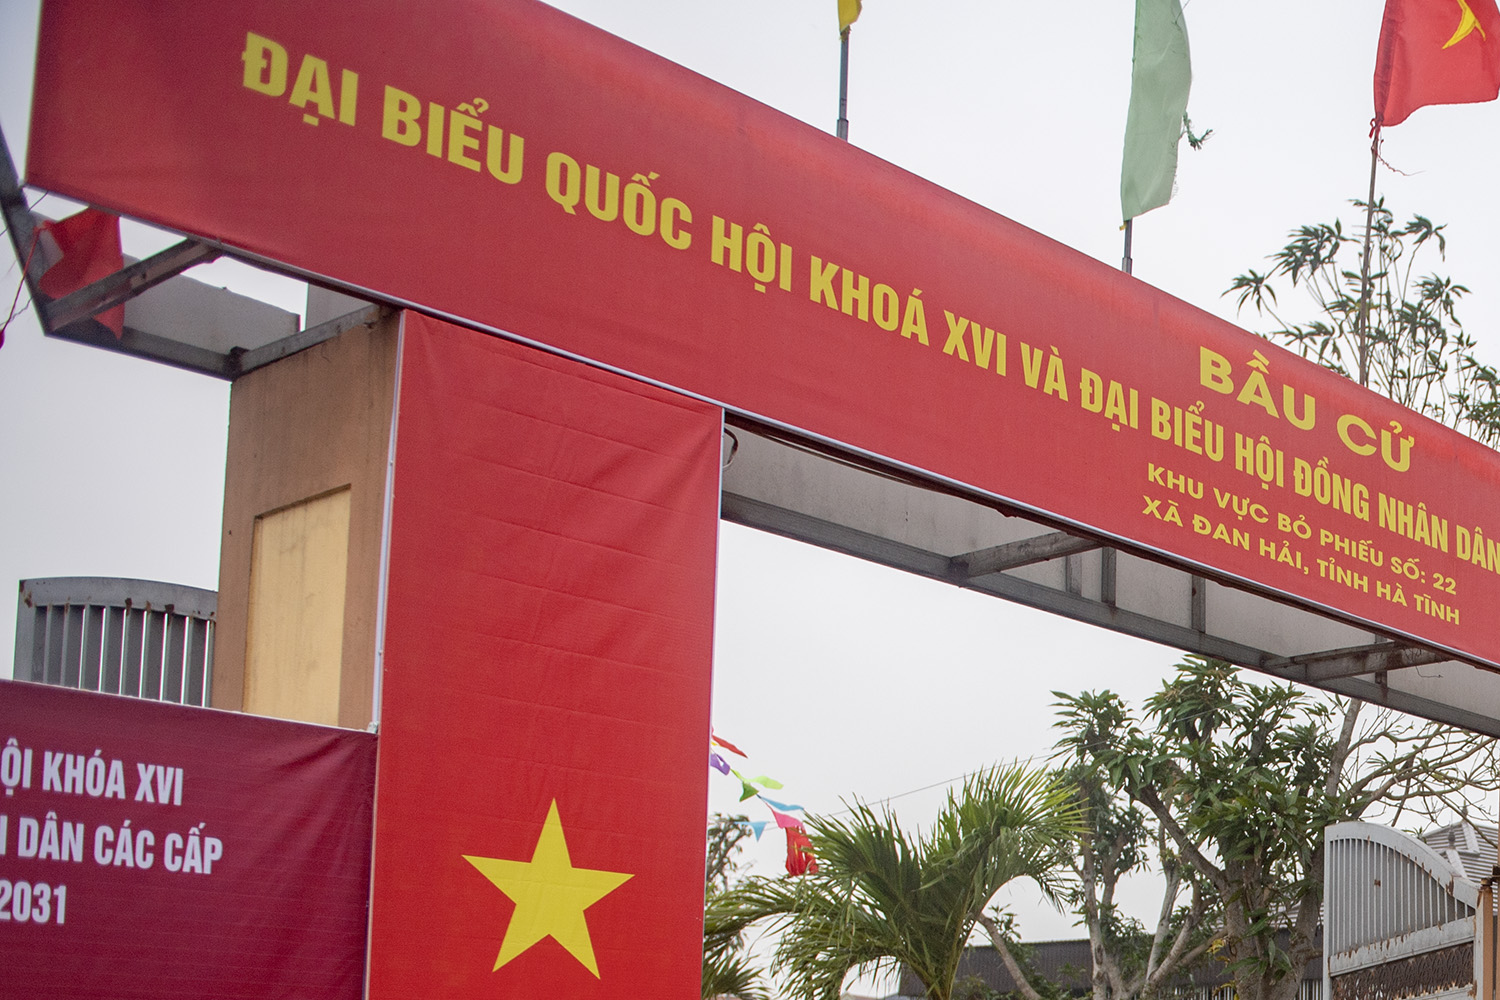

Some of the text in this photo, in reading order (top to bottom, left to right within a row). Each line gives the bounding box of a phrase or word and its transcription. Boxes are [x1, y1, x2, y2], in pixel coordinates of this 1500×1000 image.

[242, 32, 358, 126] ĐẠI
[382, 85, 524, 184] BIỂU
[546, 152, 692, 250] QUỐC
[711, 216, 792, 293] HỘI
[810, 256, 929, 346] KHOÁ
[943, 310, 1006, 376] XVI
[1020, 342, 1068, 401] VÀ
[1080, 368, 1138, 432] ĐẠI
[1151, 397, 1224, 462] BIỂU
[1235, 432, 1284, 490] HỘI
[1293, 456, 1369, 522] ĐỒNG
[1378, 492, 1448, 553] NHÂN
[1200, 346, 1415, 472] BẦU CỬ
[1142, 496, 1459, 624] XÃ ĐAN HẢI, TỈNH HÀ TĨNH
[1148, 462, 1456, 595] KHU VỰC BỎ PHIẾU SỐ: 22
[43, 750, 126, 799] KHÓA
[135, 763, 183, 805] XVI
[0, 880, 66, 924] 2031
[18, 811, 84, 861] DÂN
[94, 820, 155, 868] CÁC
[163, 823, 223, 873] CẤP
